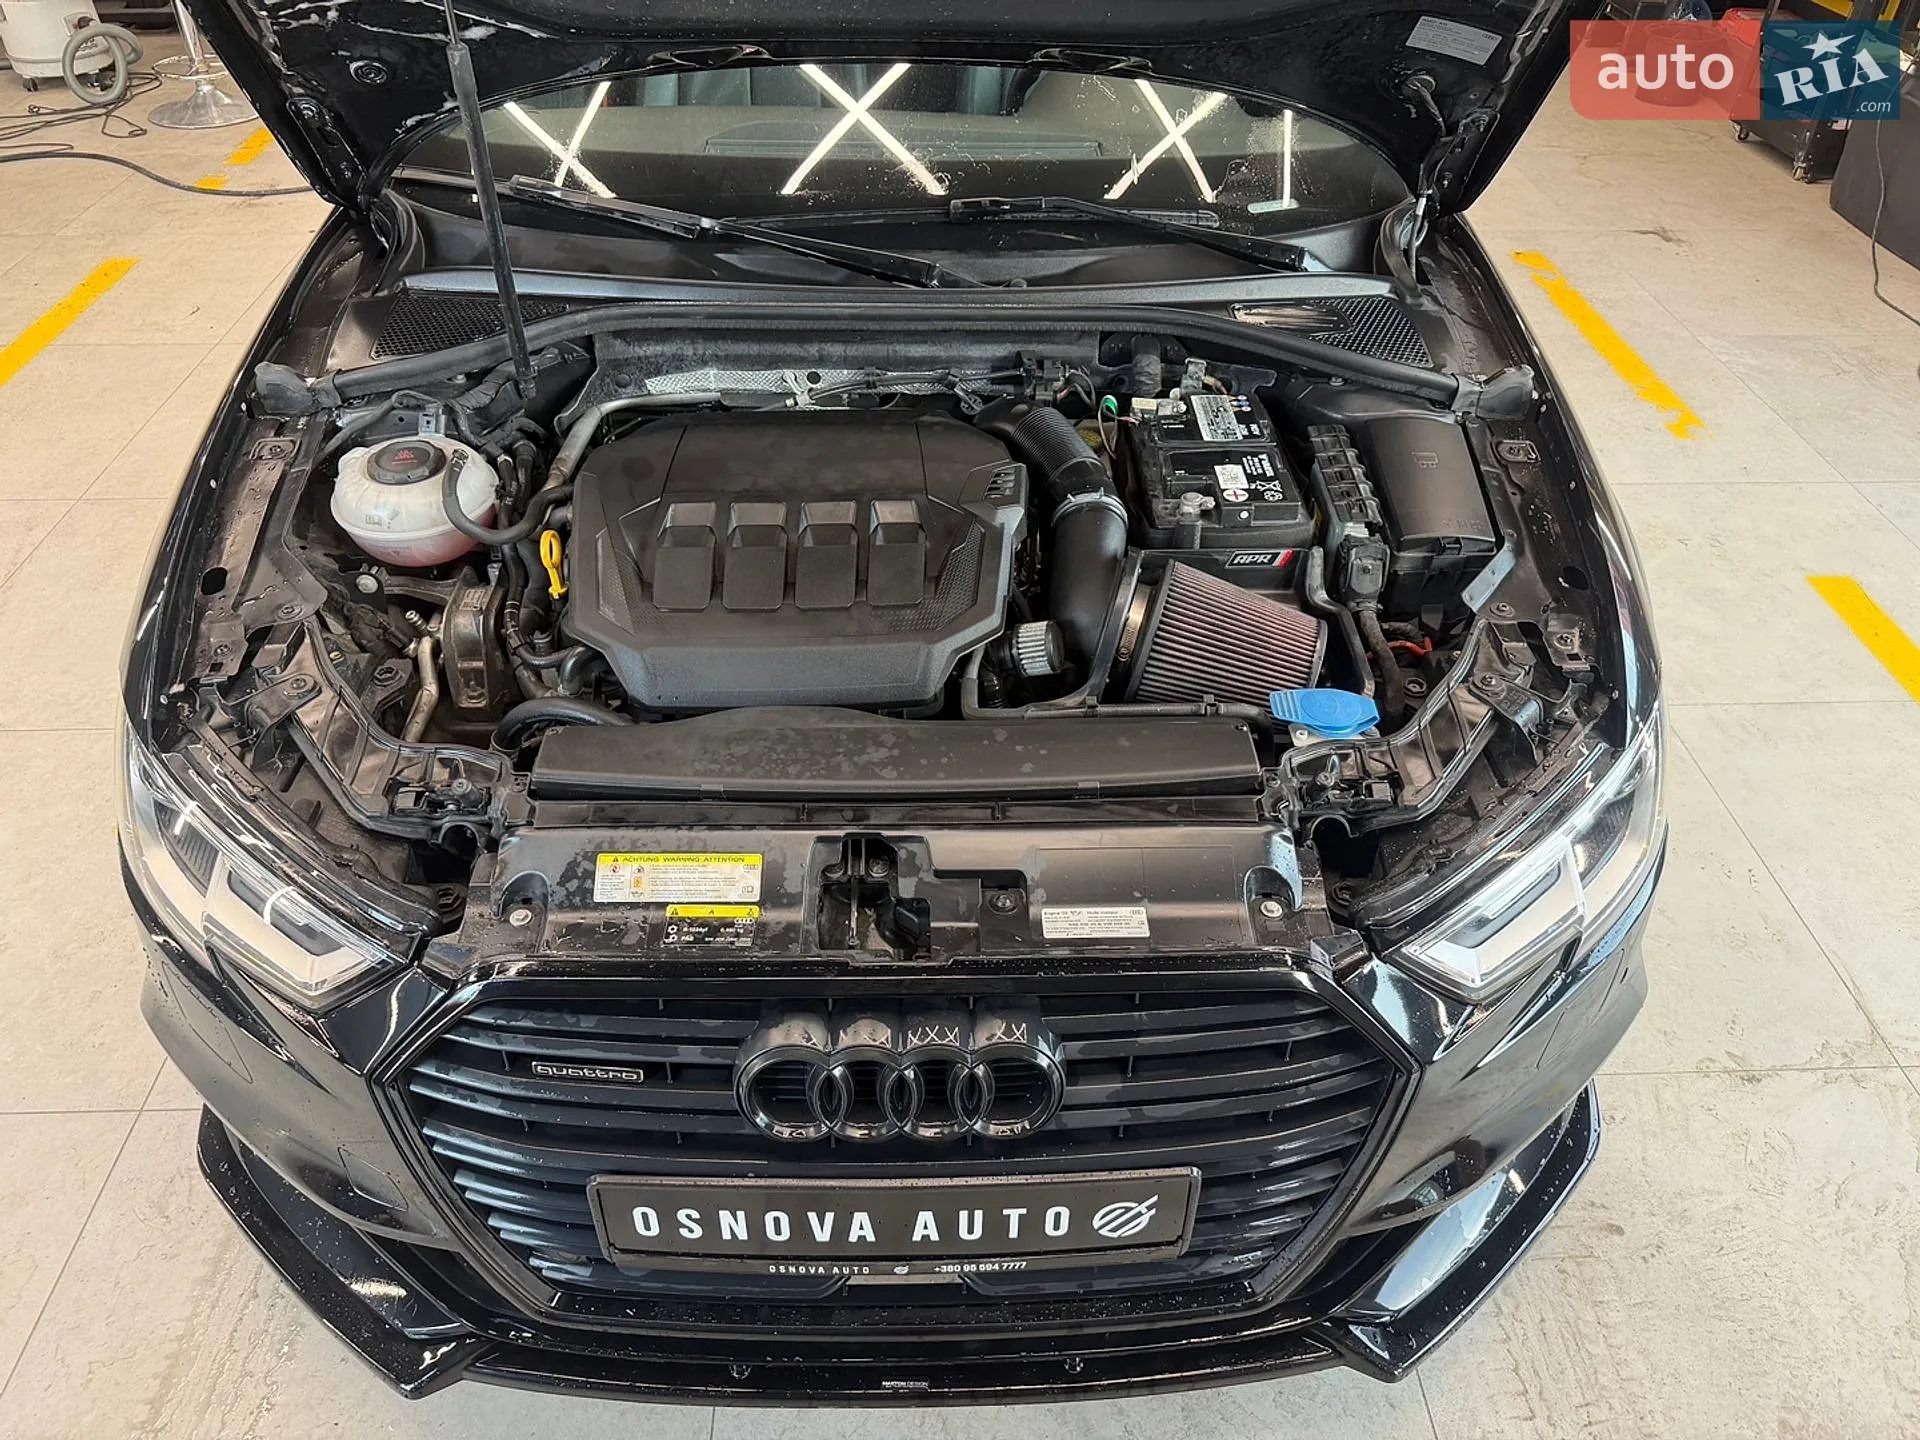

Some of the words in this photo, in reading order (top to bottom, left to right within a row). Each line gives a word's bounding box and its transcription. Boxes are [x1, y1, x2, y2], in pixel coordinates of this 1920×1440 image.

[1233, 554, 1272, 564] APR
[537, 1065, 638, 1080] quattro
[632, 1206, 876, 1243] OSNOVA
[912, 1206, 1071, 1242] AUTO
[769, 1265, 825, 1275] OSNOVA
[833, 1266, 870, 1275] AUTO
[1001, 1261, 1027, 1270] 7777
